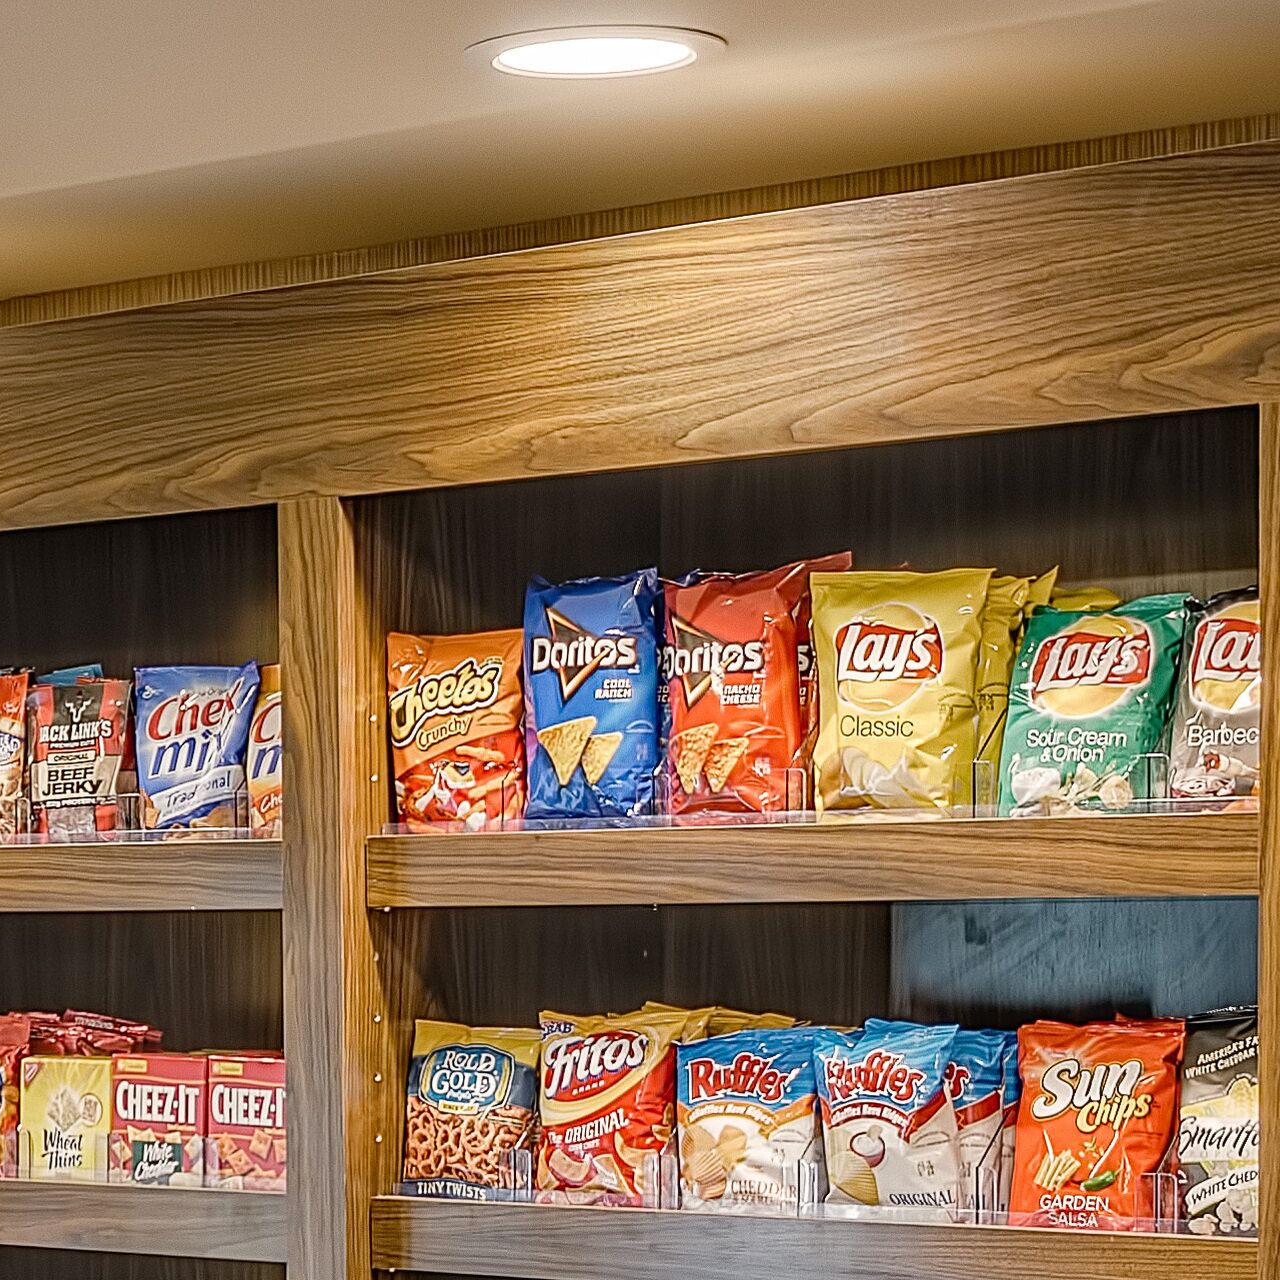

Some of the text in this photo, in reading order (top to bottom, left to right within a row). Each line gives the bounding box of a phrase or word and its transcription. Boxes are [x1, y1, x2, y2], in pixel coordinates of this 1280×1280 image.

[532, 636, 637, 672] Doritos
[837, 623, 941, 681] Lay's
[1034, 634, 1150, 694] Lay's
[604, 678, 631, 688] COOL
[390, 659, 501, 746] Cheetos
[415, 715, 473, 750] Crunchy
[841, 715, 914, 737] Classic
[1027, 728, 1127, 748] Sour Cream
[1054, 745, 1105, 763] Onion
[48, 767, 94, 781] BEEF
[42, 779, 102, 795] JERKY
[442, 1050, 496, 1071] ROLD
[544, 1032, 649, 1099] Fritos
[1185, 1063, 1216, 1079] WHITE
[431, 1069, 497, 1099] GOLD
[688, 1053, 789, 1104] Ruffles
[825, 1050, 924, 1104] Ruffles
[1033, 1059, 1144, 1119] Sun
[564, 1108, 632, 1143] ORIGINAL
[43, 1128, 83, 1151] Wheat
[43, 1149, 83, 1170] Thins
[416, 1181, 487, 1200] TINY TWISTS
[889, 1190, 954, 1207] ORIGINAL
[1192, 1179, 1226, 1205] WHITE
[1040, 1195, 1110, 1211] GARDEN
[1047, 1211, 1098, 1227] SALSA
